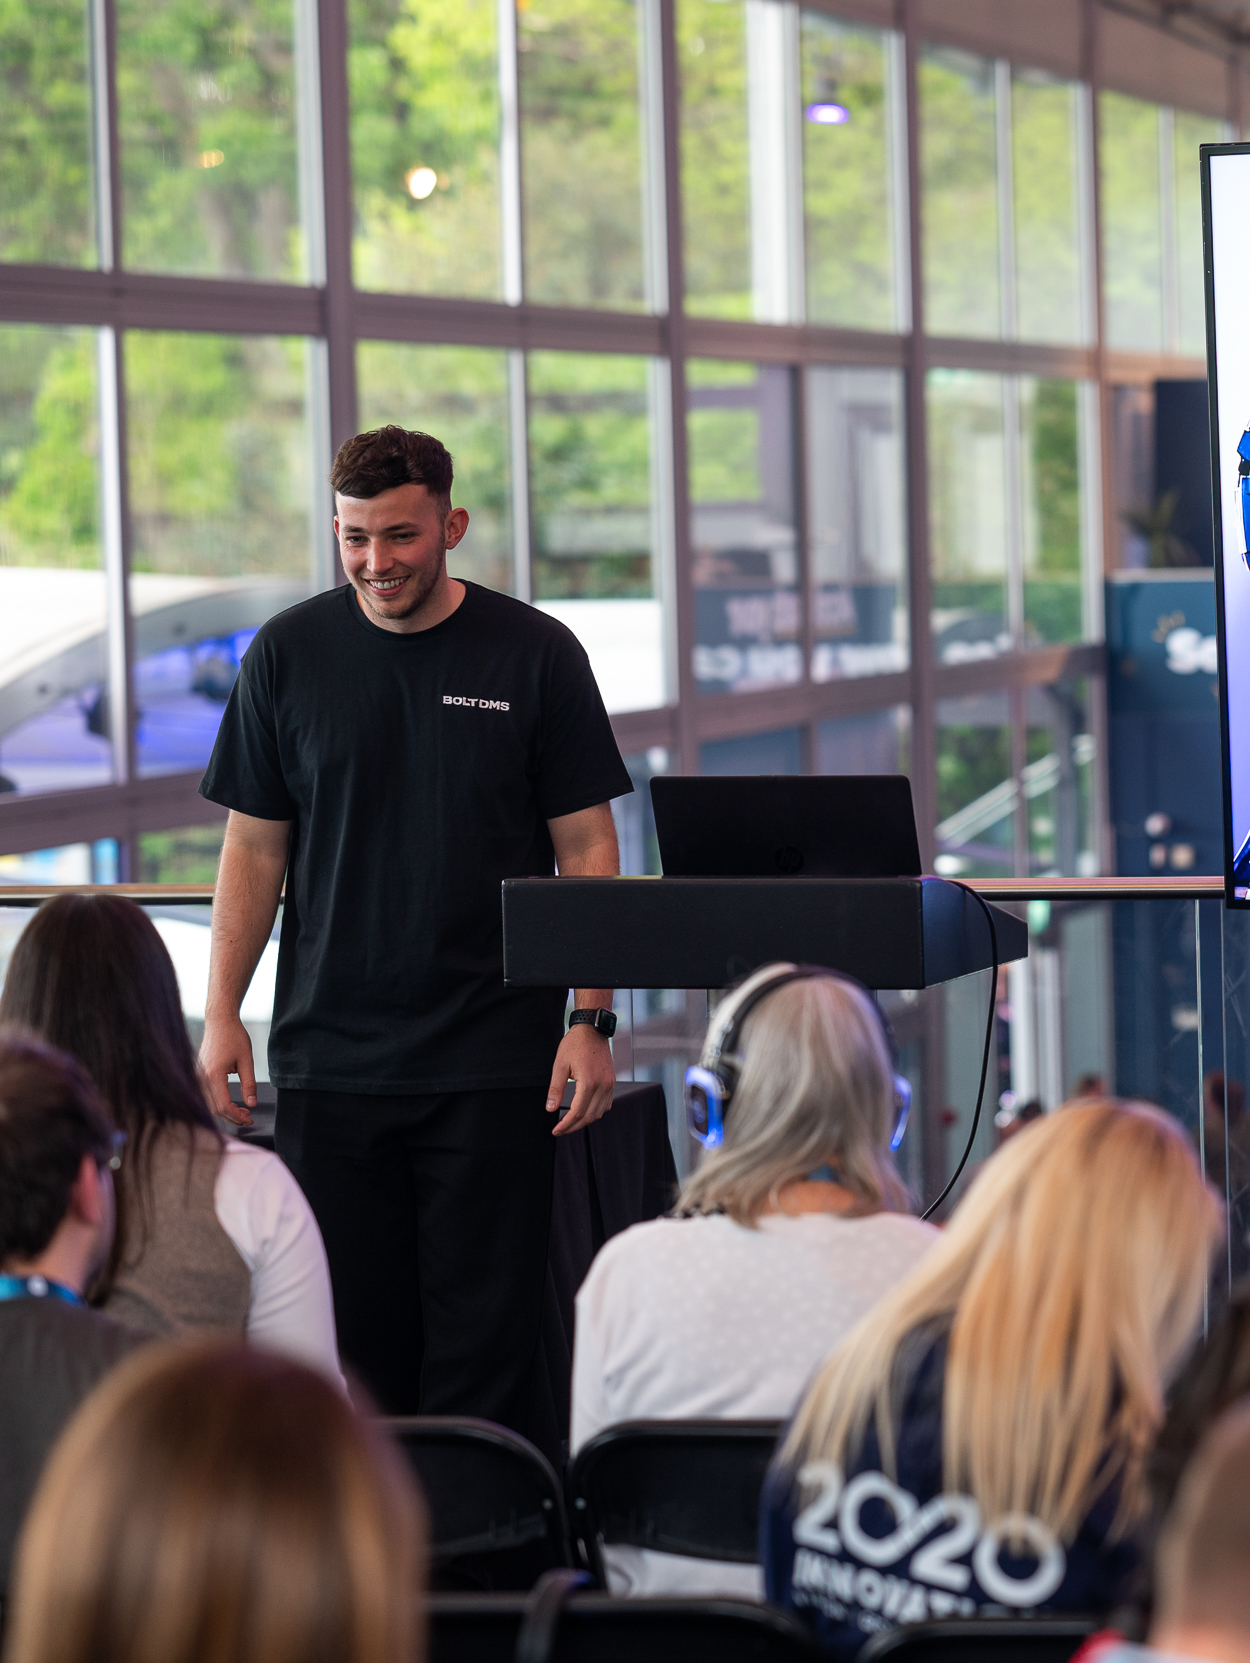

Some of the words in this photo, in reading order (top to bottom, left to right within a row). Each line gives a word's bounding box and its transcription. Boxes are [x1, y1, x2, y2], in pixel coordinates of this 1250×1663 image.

[442, 695, 479, 707] BOLT
[478, 698, 510, 711] DMS
[793, 1459, 1068, 1609] 2020
